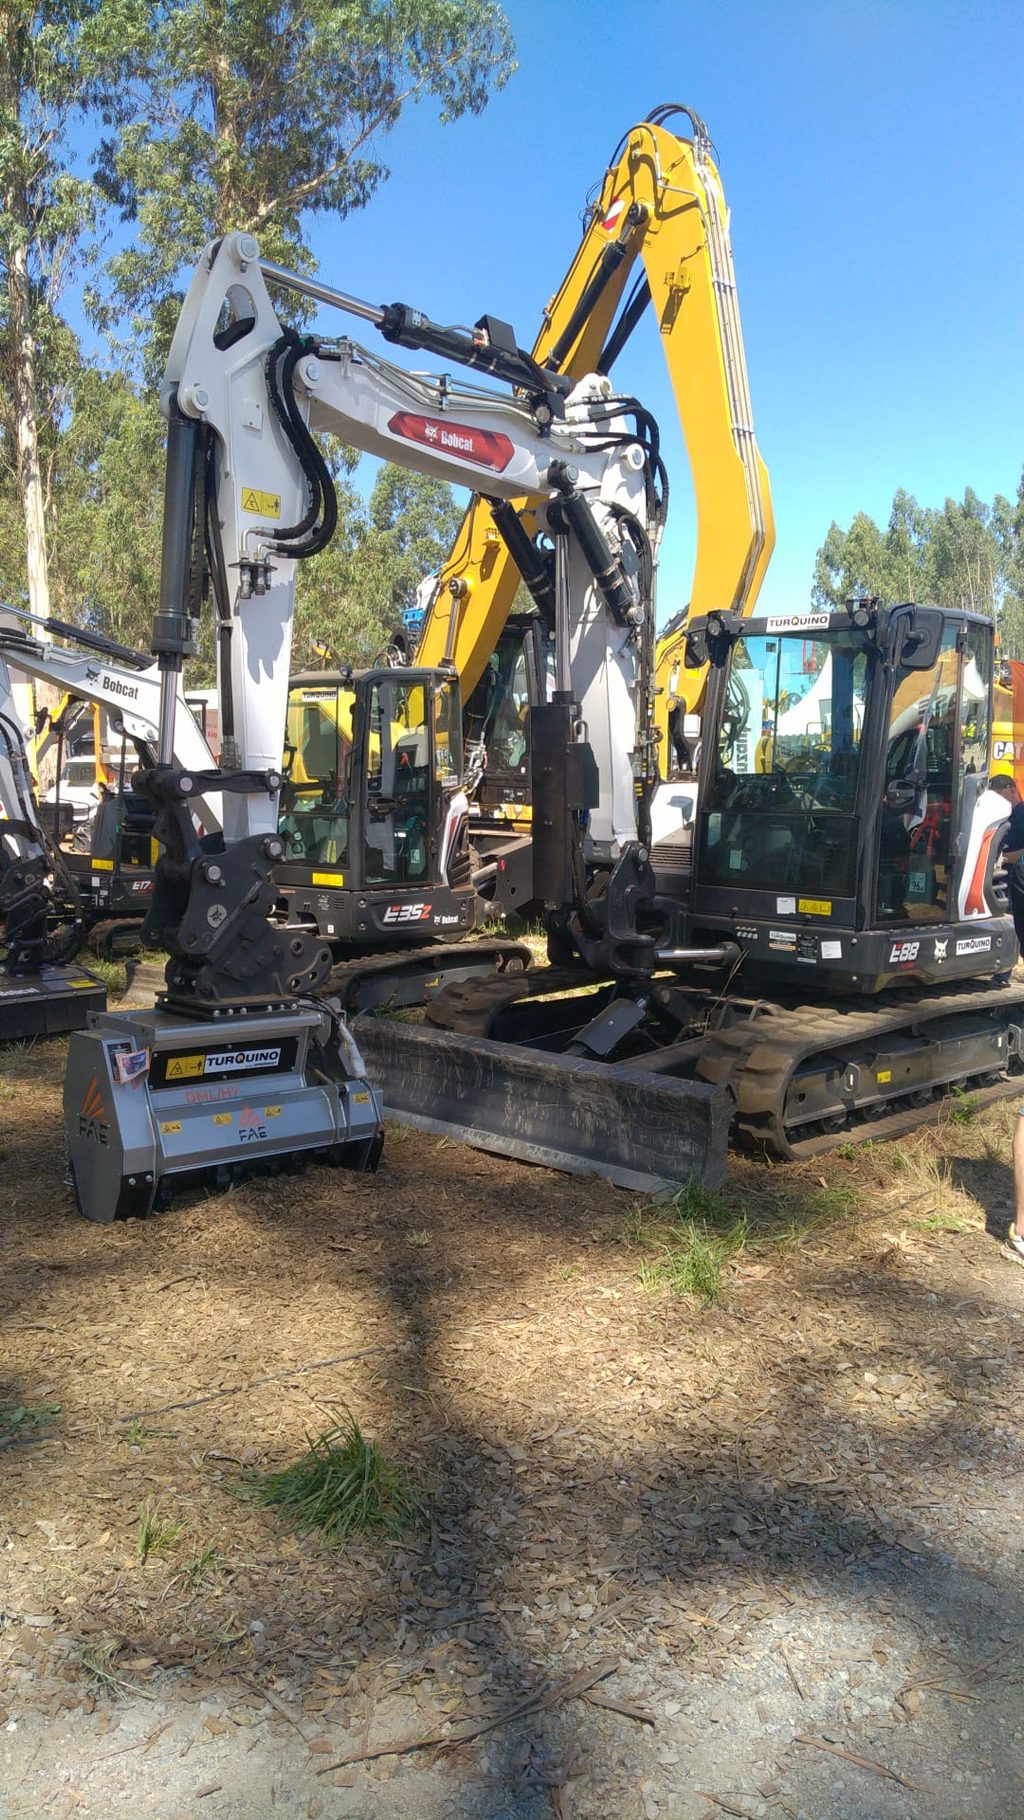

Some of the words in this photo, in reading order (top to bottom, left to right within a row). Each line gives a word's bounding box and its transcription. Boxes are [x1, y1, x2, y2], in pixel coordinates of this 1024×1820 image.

[441, 431, 473, 452] Bobcat
[770, 616, 828, 627] TURQUINO
[103, 676, 138, 699] Bobcat
[993, 741, 1024, 760] CAT
[889, 942, 920, 962] E88
[958, 939, 990, 949] TURQUINO
[207, 1051, 279, 1067] TURQUINO
[80, 1116, 109, 1145] FAE
[239, 1126, 268, 1142] FAE
